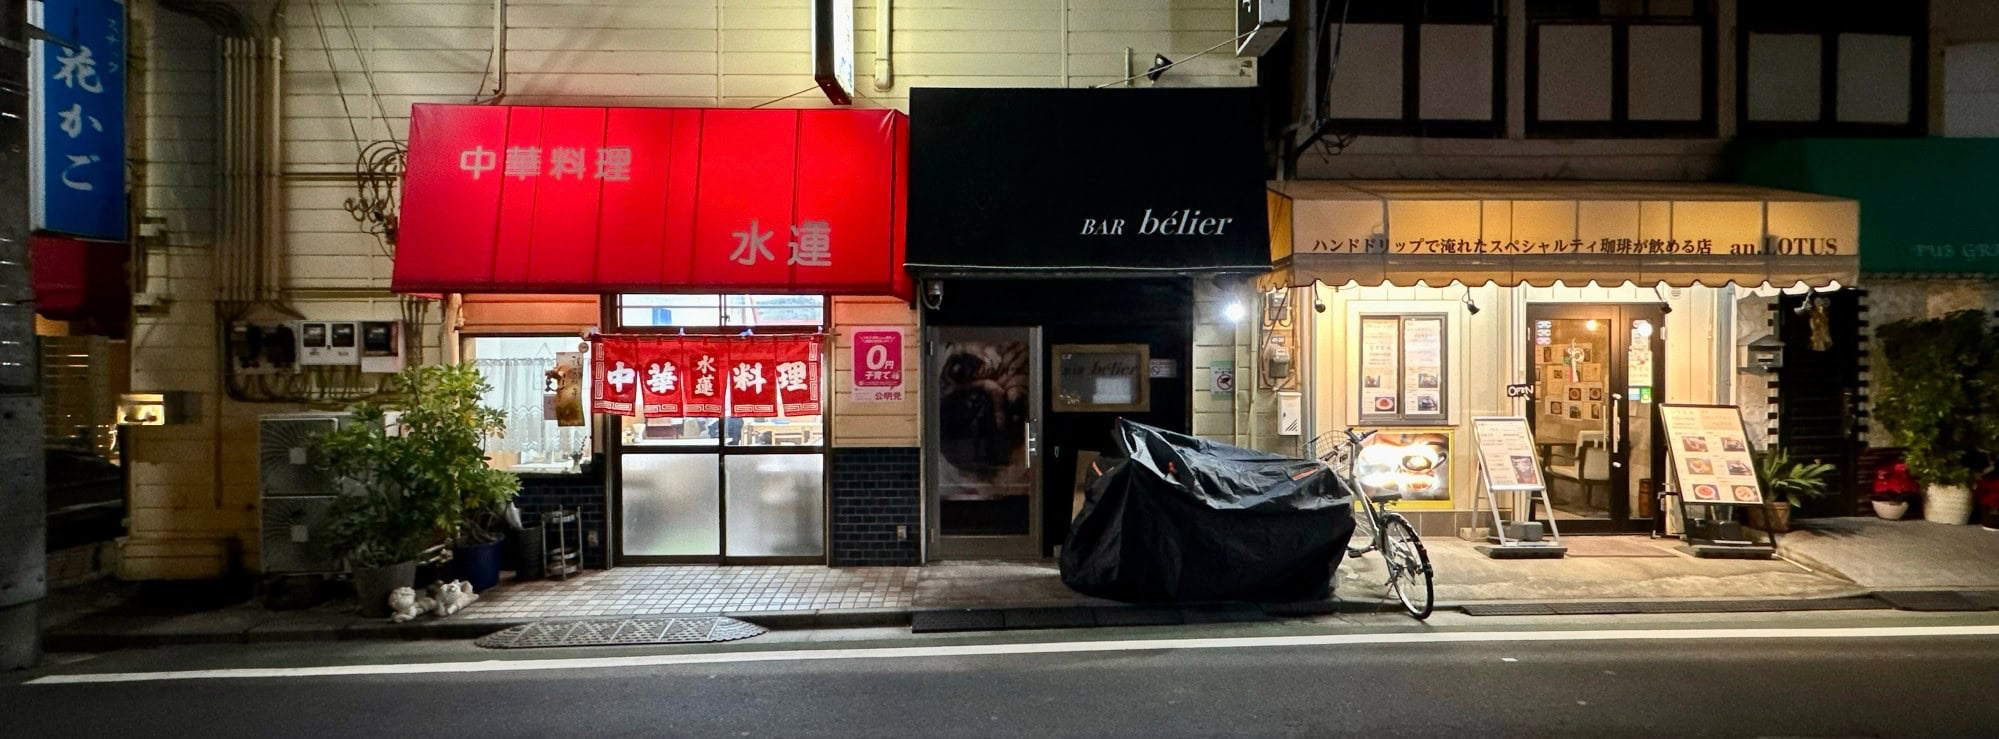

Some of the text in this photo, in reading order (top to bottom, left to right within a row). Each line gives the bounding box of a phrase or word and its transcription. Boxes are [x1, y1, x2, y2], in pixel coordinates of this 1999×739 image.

[52, 45, 104, 191] 花かご
[460, 145, 632, 182] 中華料理
[1080, 208, 1233, 235] BAR bélier
[606, 361, 679, 394] 中華
[694, 354, 716, 397] 水蓮
[732, 361, 808, 394] 料理
[866, 344, 895, 371] 0円
